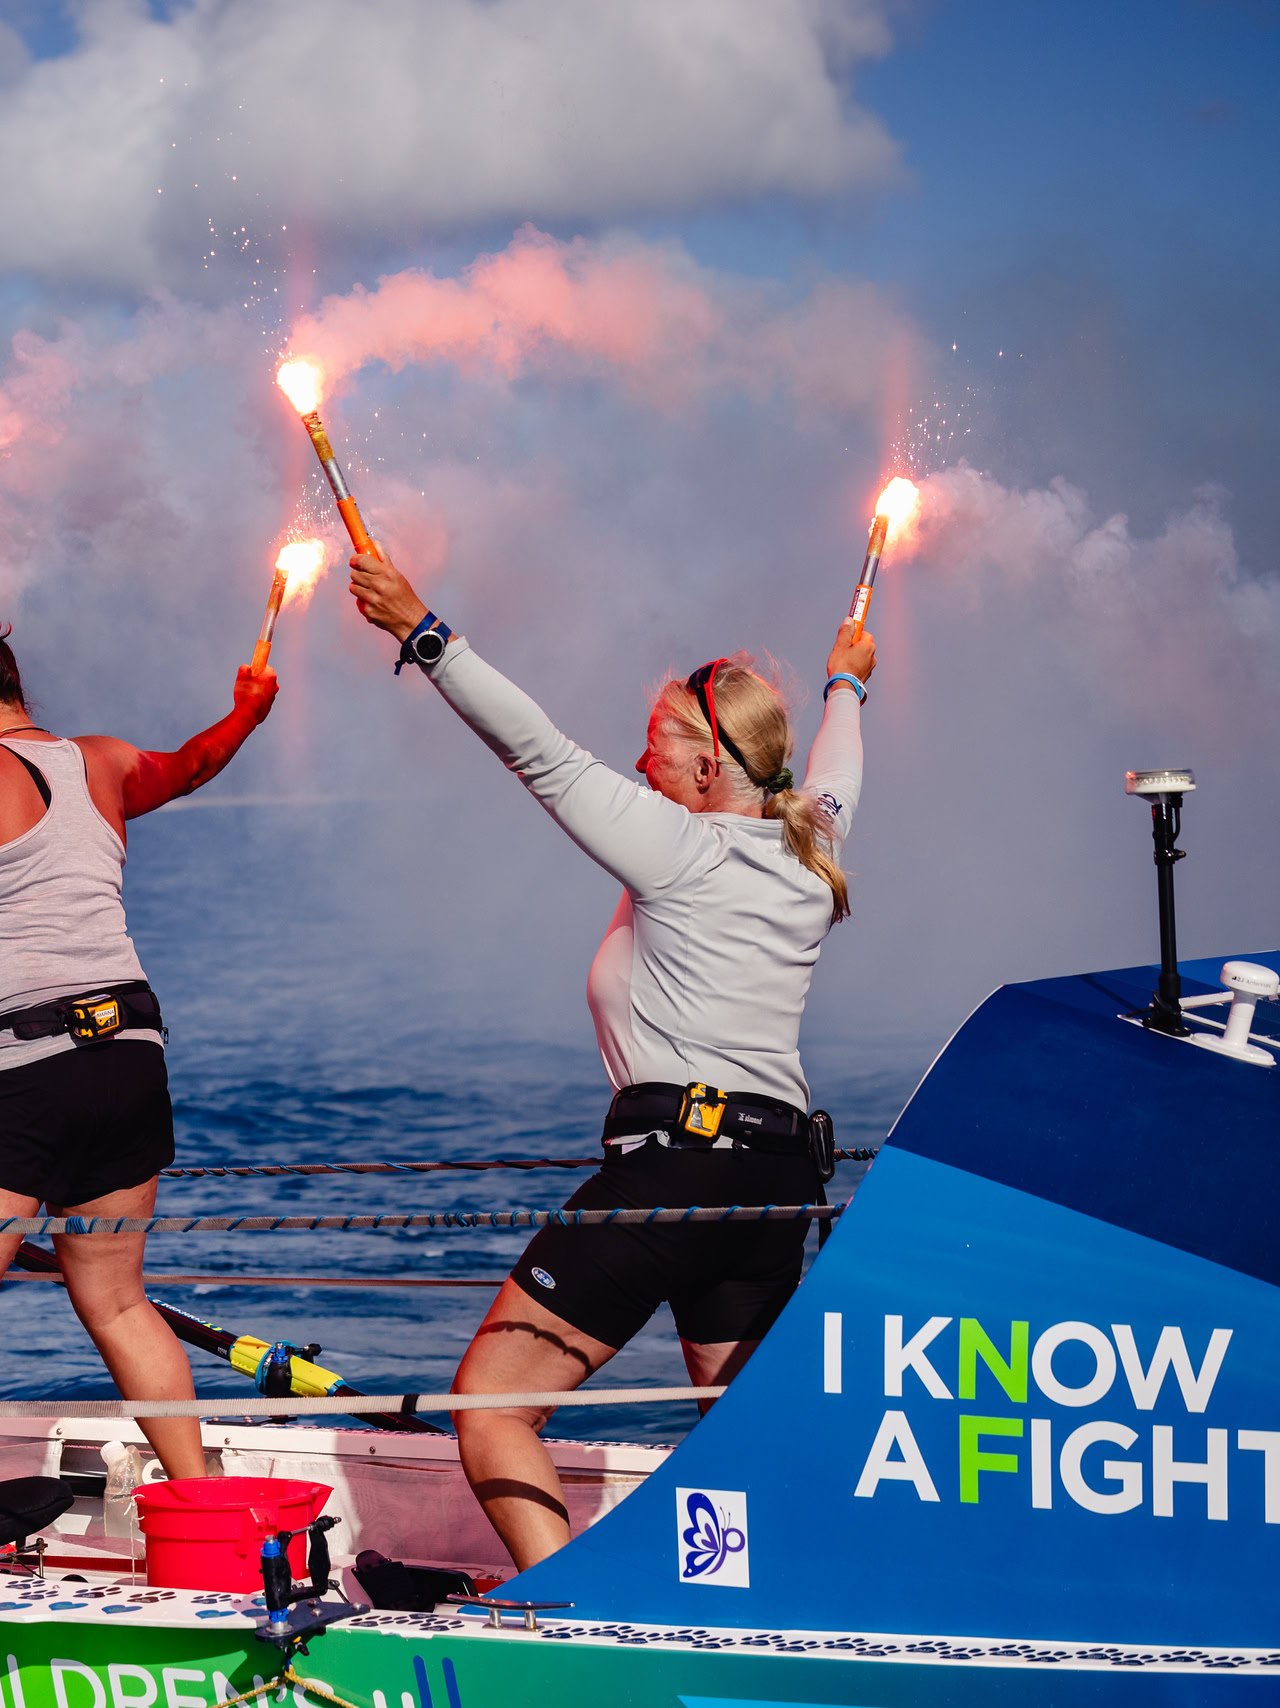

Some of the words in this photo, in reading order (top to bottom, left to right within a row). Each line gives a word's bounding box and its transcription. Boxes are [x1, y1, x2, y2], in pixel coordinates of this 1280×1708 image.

[824, 1312, 843, 1394] I
[884, 1314, 1234, 1413] KNOW
[854, 1410, 941, 1503] A
[959, 1415, 1280, 1524] FIGHT
